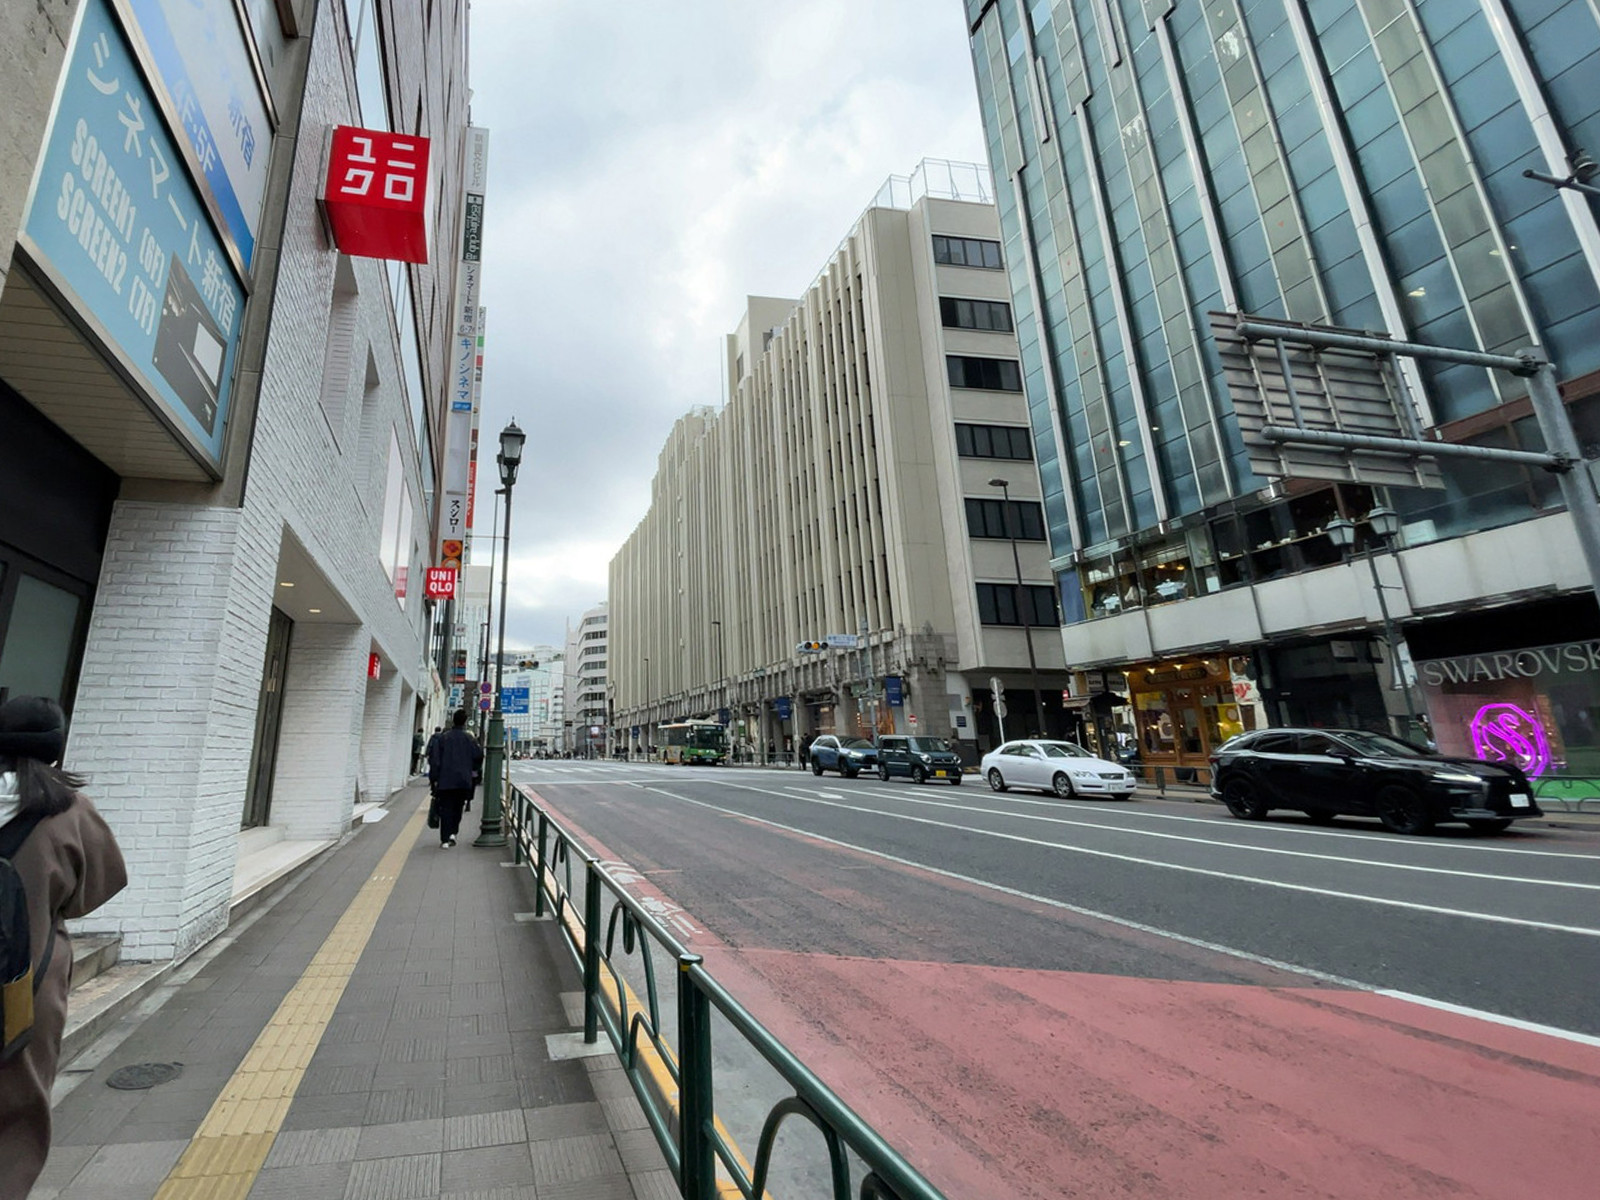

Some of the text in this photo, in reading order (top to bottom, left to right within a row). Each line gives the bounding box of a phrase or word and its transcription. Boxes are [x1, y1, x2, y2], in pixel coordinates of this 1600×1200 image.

[347, 136, 416, 170] ユニ
[87, 33, 236, 337] シネマート新宿
[340, 168, 414, 202] クロ
[71, 117, 166, 289] SCREEN1 (6F)
[57, 171, 157, 336] SCREEN2 (7F)
[457, 338, 471, 399] キノシネマ
[449, 500, 460, 533] スシロー
[429, 582, 453, 592] QLO
[430, 570, 451, 581] UNI
